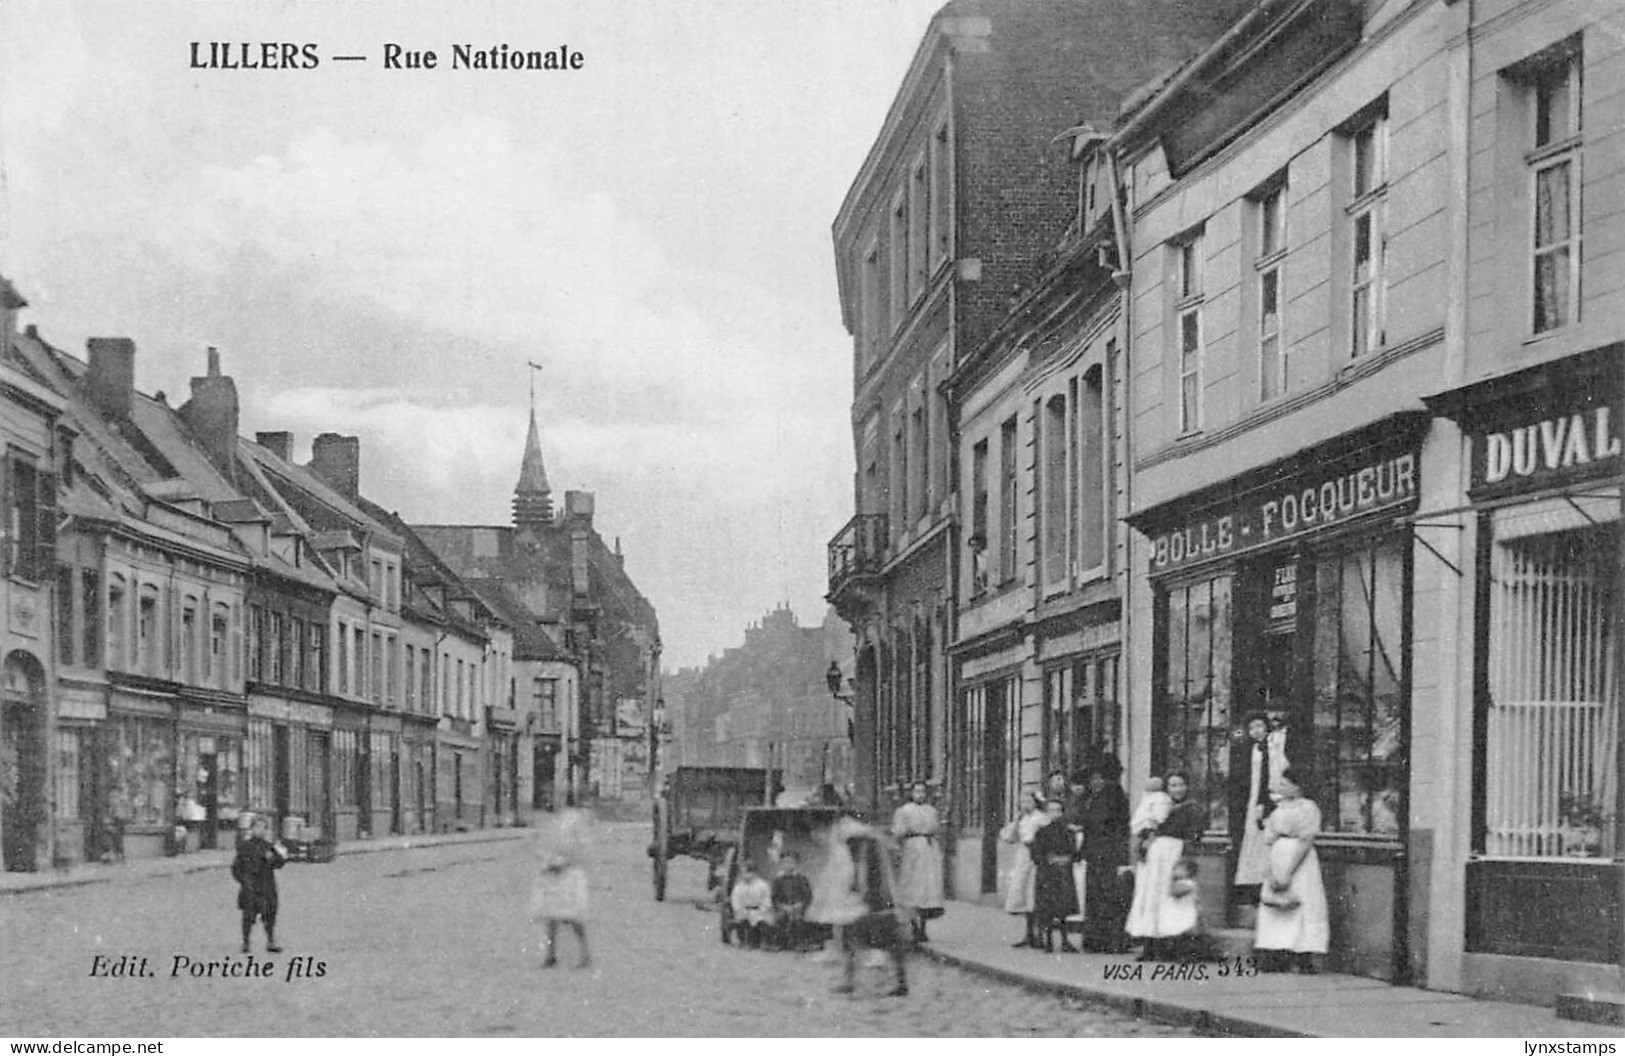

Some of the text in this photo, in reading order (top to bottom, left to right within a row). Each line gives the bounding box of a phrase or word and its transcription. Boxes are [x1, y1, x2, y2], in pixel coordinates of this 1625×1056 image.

[1485, 406, 1621, 484] DUVAL
[1154, 516, 1233, 566] BOLLE
[1262, 453, 1416, 536] FOCQUEUR
